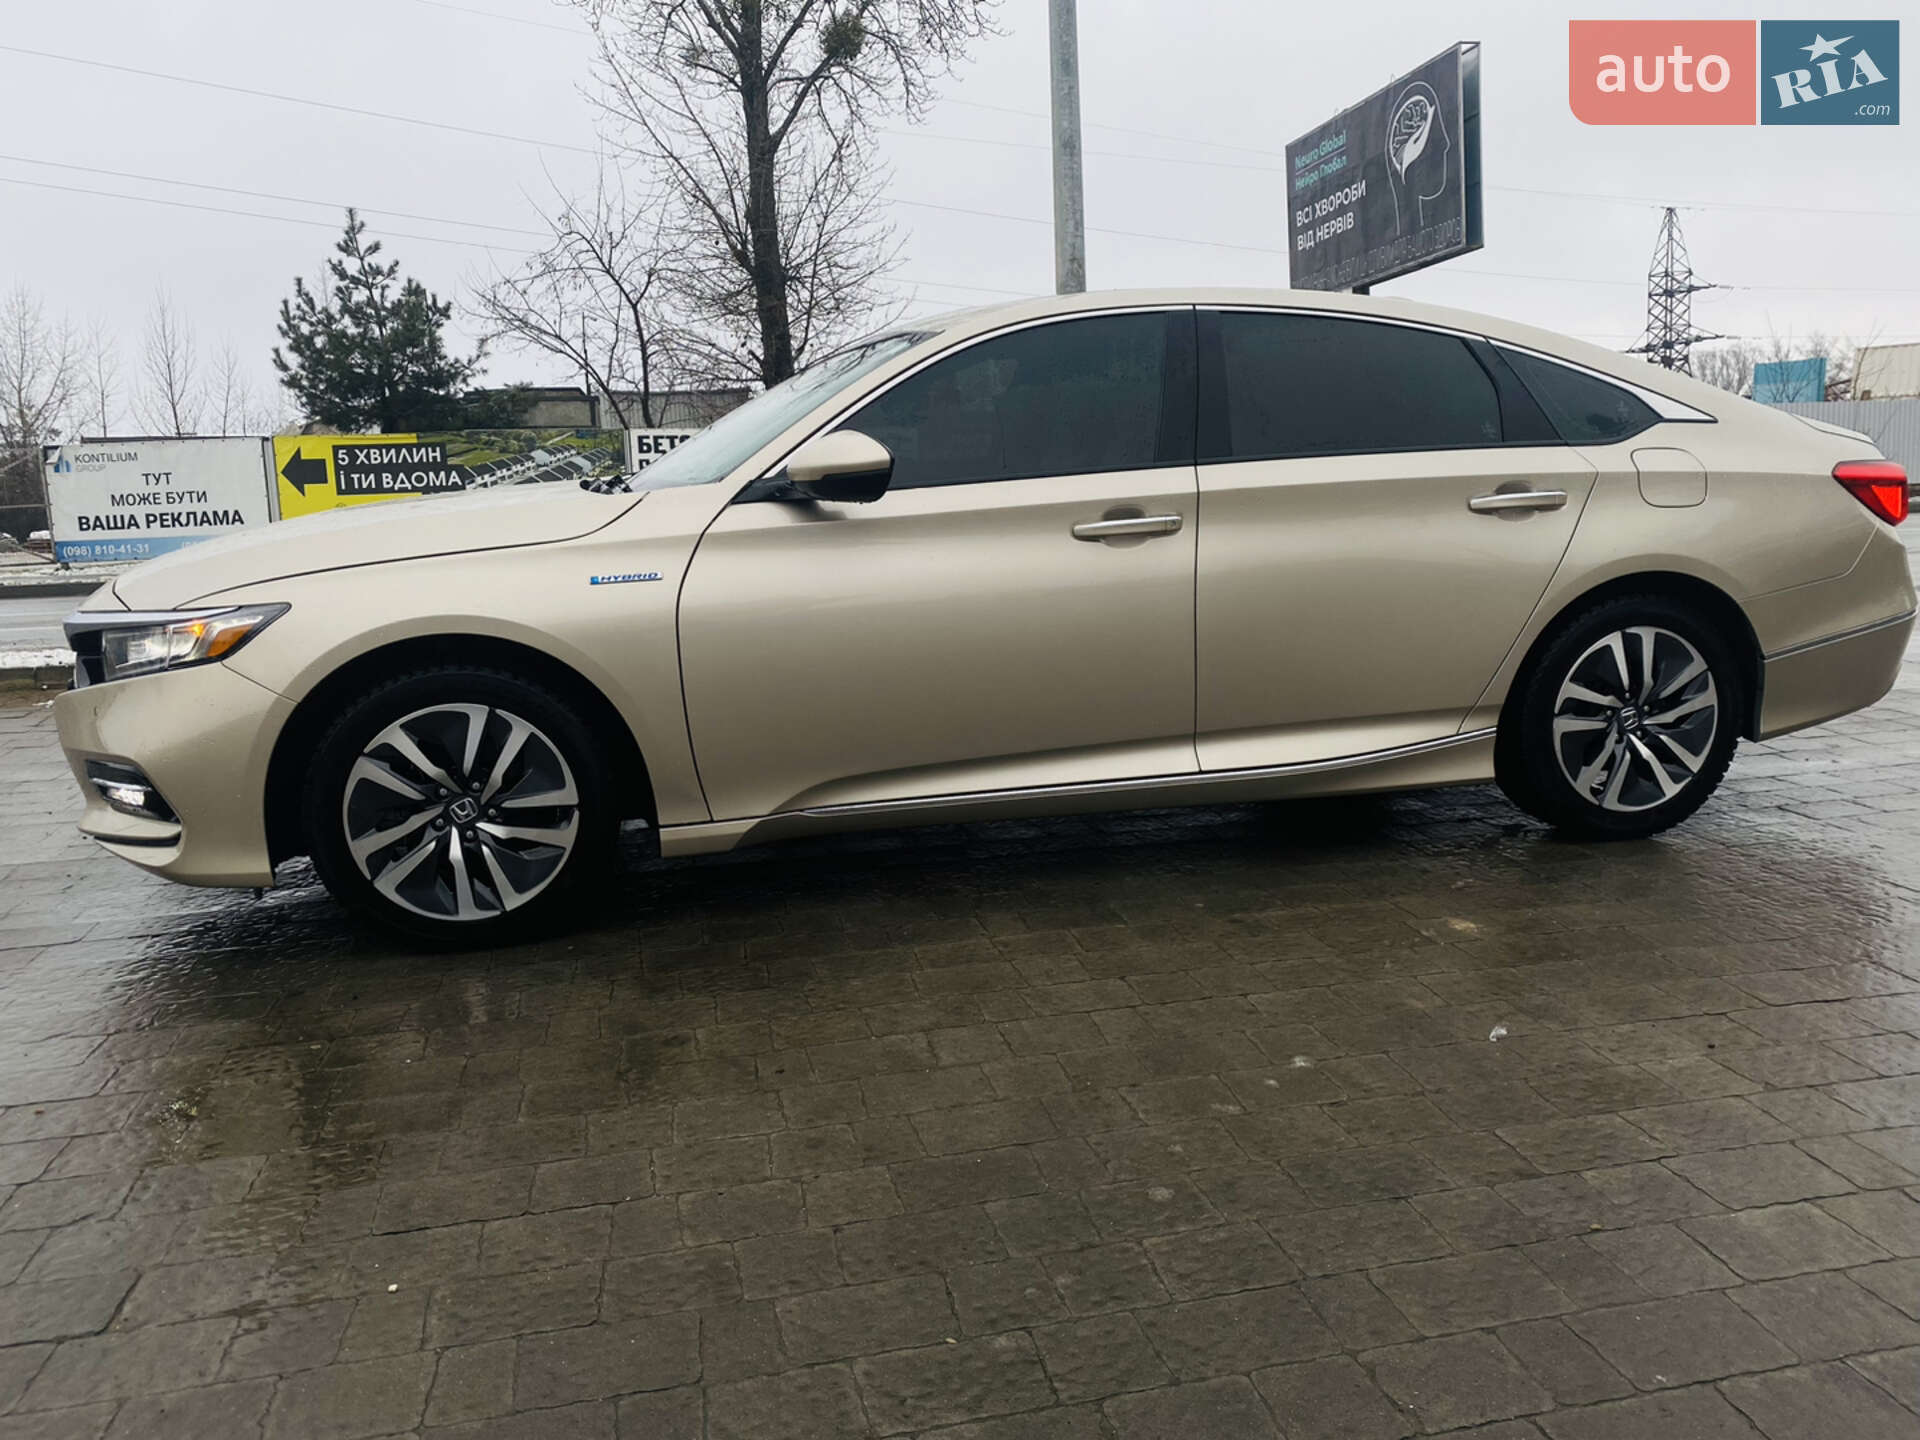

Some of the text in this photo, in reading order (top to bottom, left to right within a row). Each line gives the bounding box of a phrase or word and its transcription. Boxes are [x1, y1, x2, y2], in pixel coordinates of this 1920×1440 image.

[1319, 130, 1346, 156] Global
[1296, 179, 1366, 227] ВСІ ХВОРОБИ
[1297, 212, 1354, 251] ВІД НЕРВІВ
[637, 434, 690, 454] БЕТ
[74, 452, 138, 464] KONTILIUM
[337, 446, 442, 465] 5 ХВИЛИН
[142, 472, 172, 486] ТУТ
[350, 472, 377, 489] ТИ
[381, 470, 463, 490] ВДОМА
[111, 490, 208, 507] МОЖЕ БУТИ
[77, 509, 245, 532] ВАША РЕКЛАМА
[63, 542, 150, 557] (098) 810-41-31
